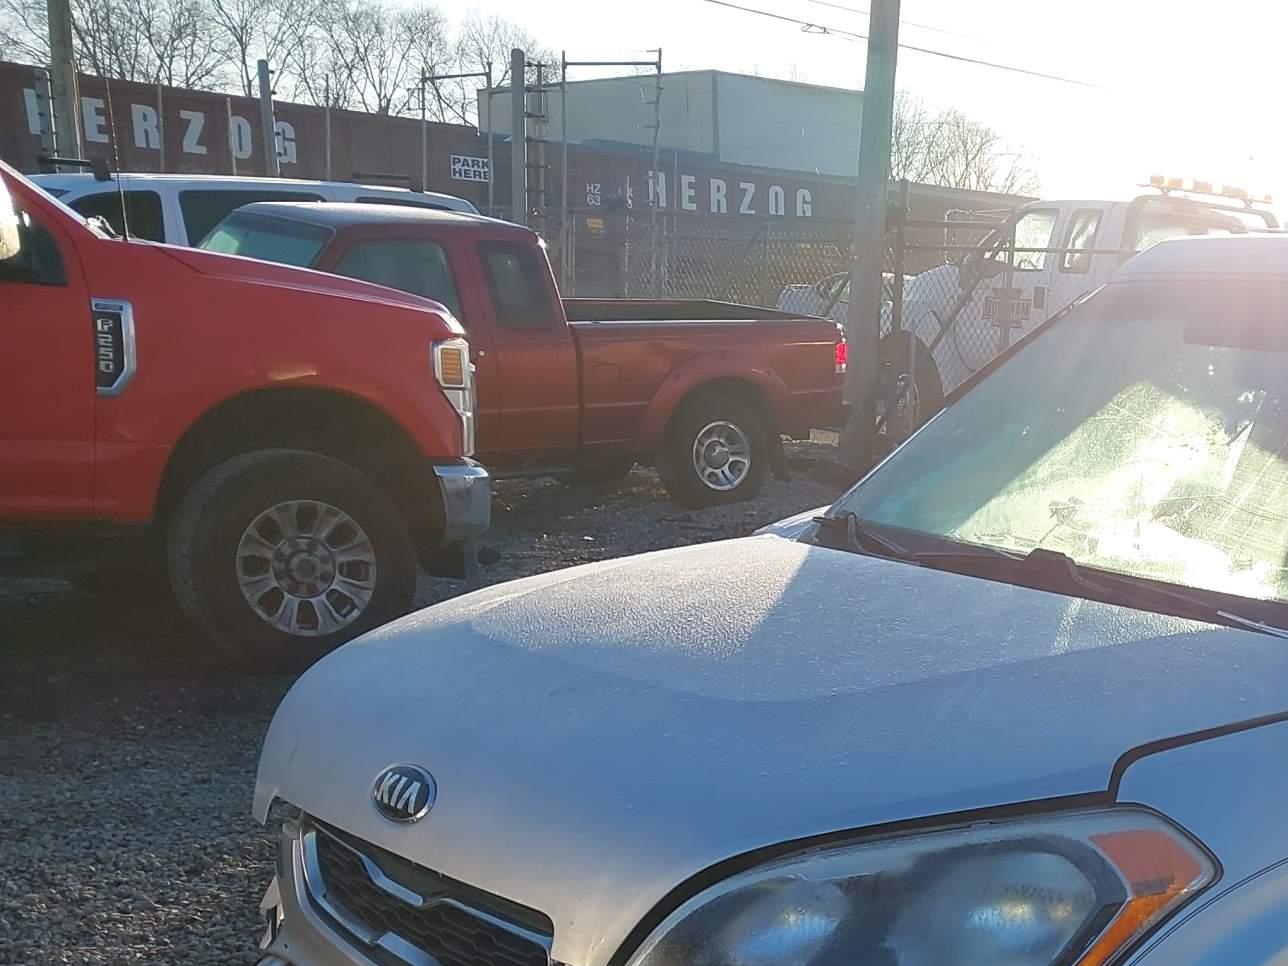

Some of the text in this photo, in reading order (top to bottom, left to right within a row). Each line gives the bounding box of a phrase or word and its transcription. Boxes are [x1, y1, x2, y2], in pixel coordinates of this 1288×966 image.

[452, 157, 488, 169] PARK
[452, 168, 488, 180] HERE
[647, 170, 812, 217] HERZOG
[376, 771, 421, 815] KIA
